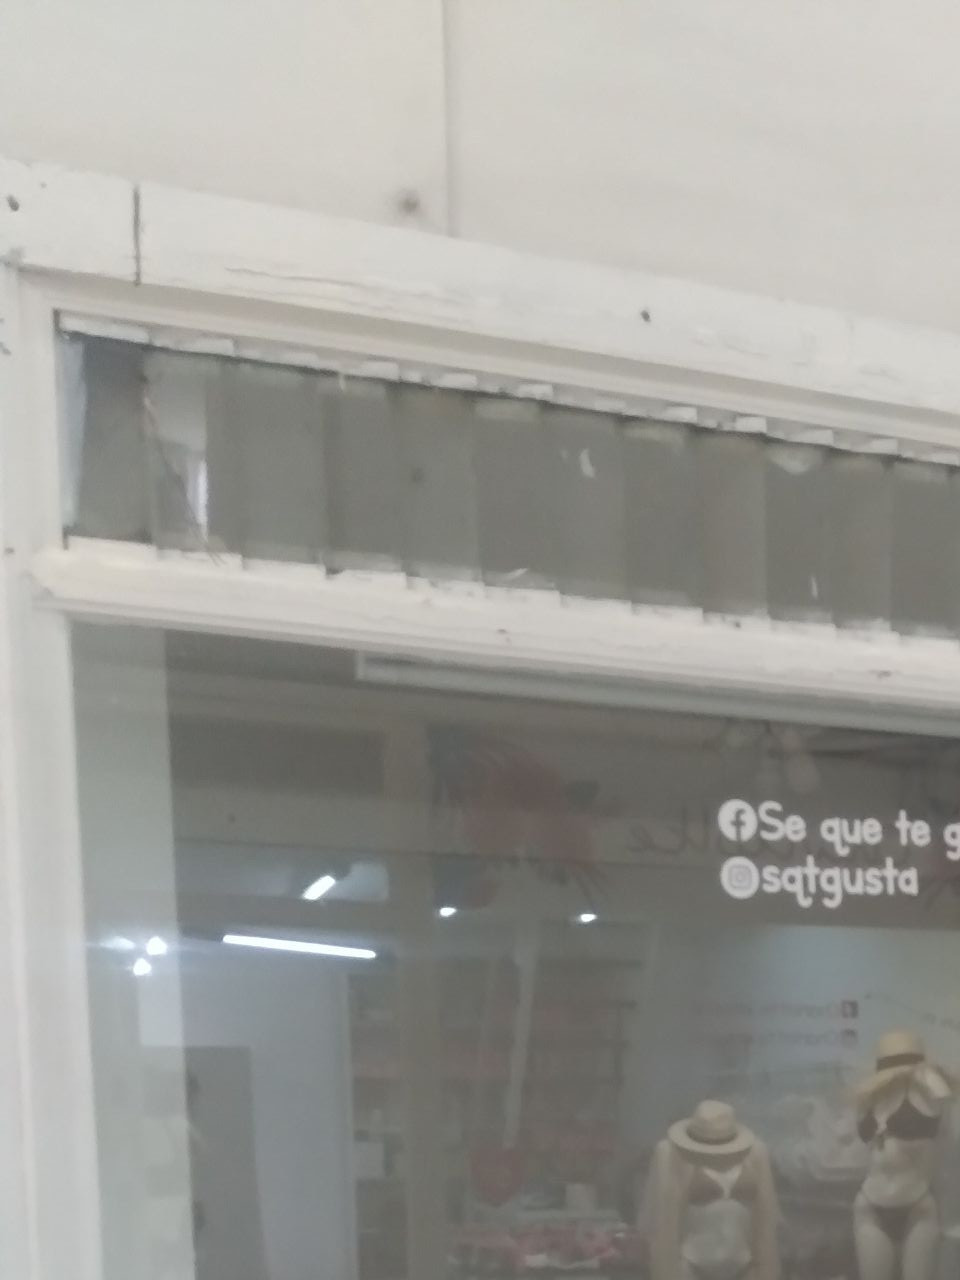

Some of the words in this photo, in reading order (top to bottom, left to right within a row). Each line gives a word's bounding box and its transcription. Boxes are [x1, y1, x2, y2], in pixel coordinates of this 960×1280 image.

[758, 800, 806, 842] Se
[820, 817, 882, 857] que
[895, 809, 931, 847] te
[762, 854, 918, 908] sqtgusta
